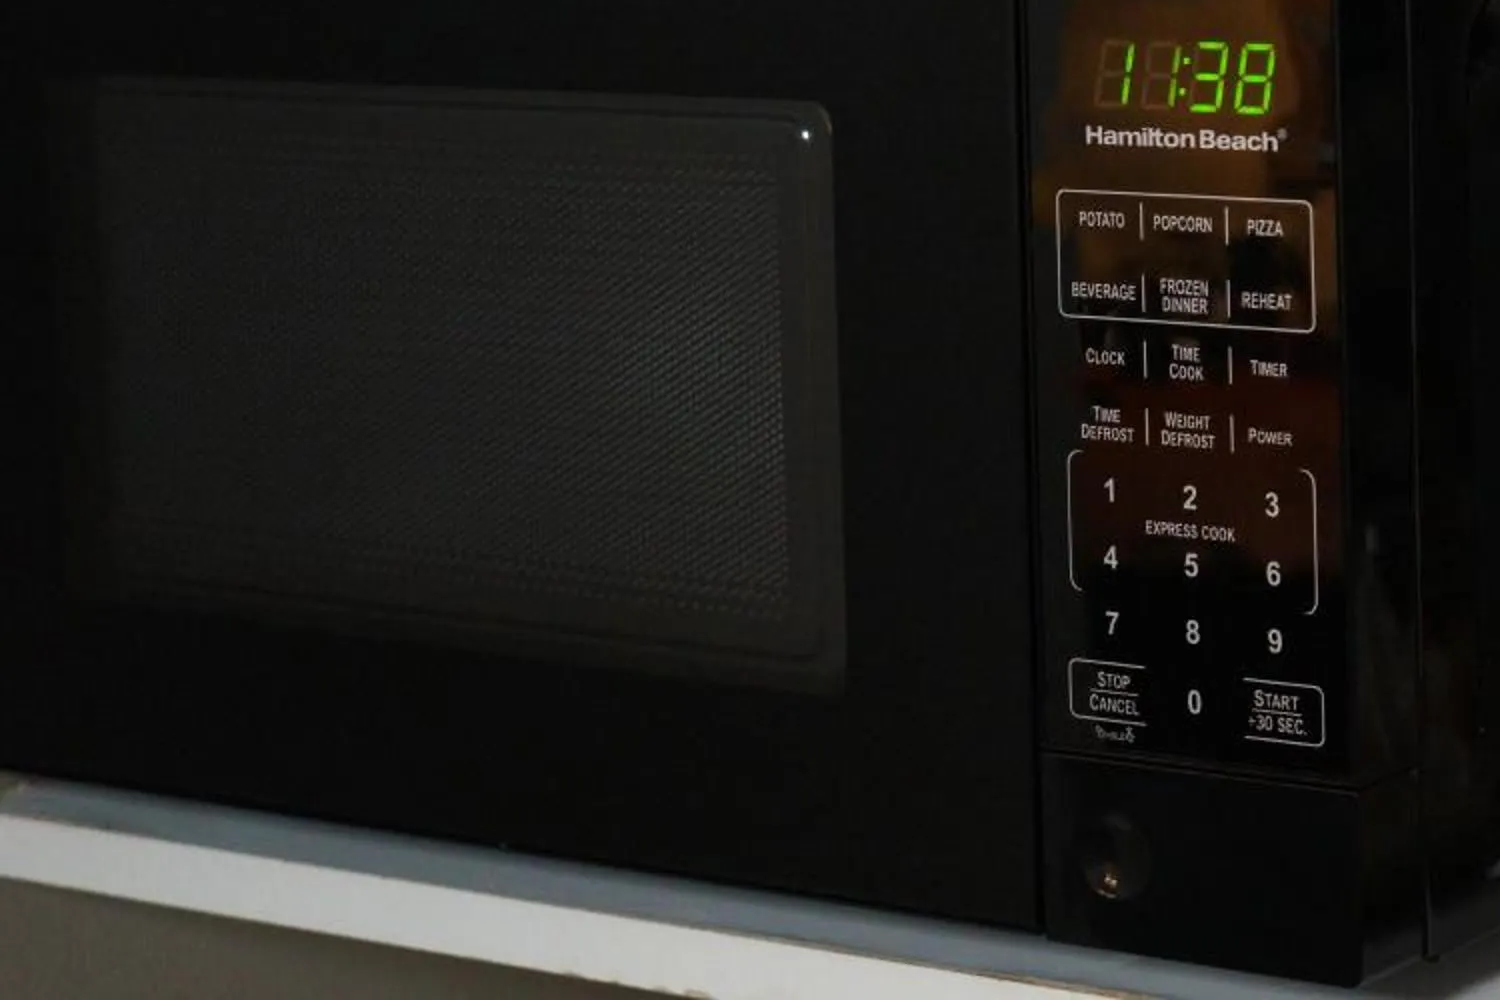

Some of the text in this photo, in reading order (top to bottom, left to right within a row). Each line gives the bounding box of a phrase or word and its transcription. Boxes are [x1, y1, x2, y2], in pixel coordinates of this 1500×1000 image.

[1120, 41, 1275, 114] 11:38
[1085, 125, 1196, 149] Hamilton
[1079, 211, 1125, 228] POTATO
[1153, 215, 1213, 233] POPCORN
[1247, 219, 1284, 237] PIZZA
[1071, 282, 1136, 301] BEVERAGE
[1160, 278, 1208, 297] FROZEN
[1162, 296, 1207, 314] DINNER
[1241, 291, 1292, 310] REHEAT
[1086, 348, 1125, 366] CLOCK
[1172, 344, 1200, 362] TIME
[1169, 363, 1204, 381] COOK
[1250, 360, 1288, 377] TIMER
[1092, 406, 1120, 423] TIME
[1164, 411, 1210, 430] WEIGHT
[1081, 424, 1134, 442] DEFROST
[1161, 430, 1216, 450] DEFROST
[1248, 428, 1292, 446] POWER
[1104, 478, 1115, 502] 1
[1183, 485, 1197, 510] 2
[1266, 492, 1280, 518] 3
[1146, 520, 1236, 542] EXPRESS COOK
[1104, 546, 1118, 569] 4
[1184, 552, 1198, 577] 5
[1266, 561, 1281, 586] 6
[1106, 611, 1119, 635] 7
[1186, 620, 1200, 644] 8
[1268, 629, 1282, 654] 9
[1098, 672, 1130, 690] STOP
[1090, 693, 1140, 716] CANCEL
[1188, 690, 1201, 714] 0
[1254, 690, 1298, 711] START
